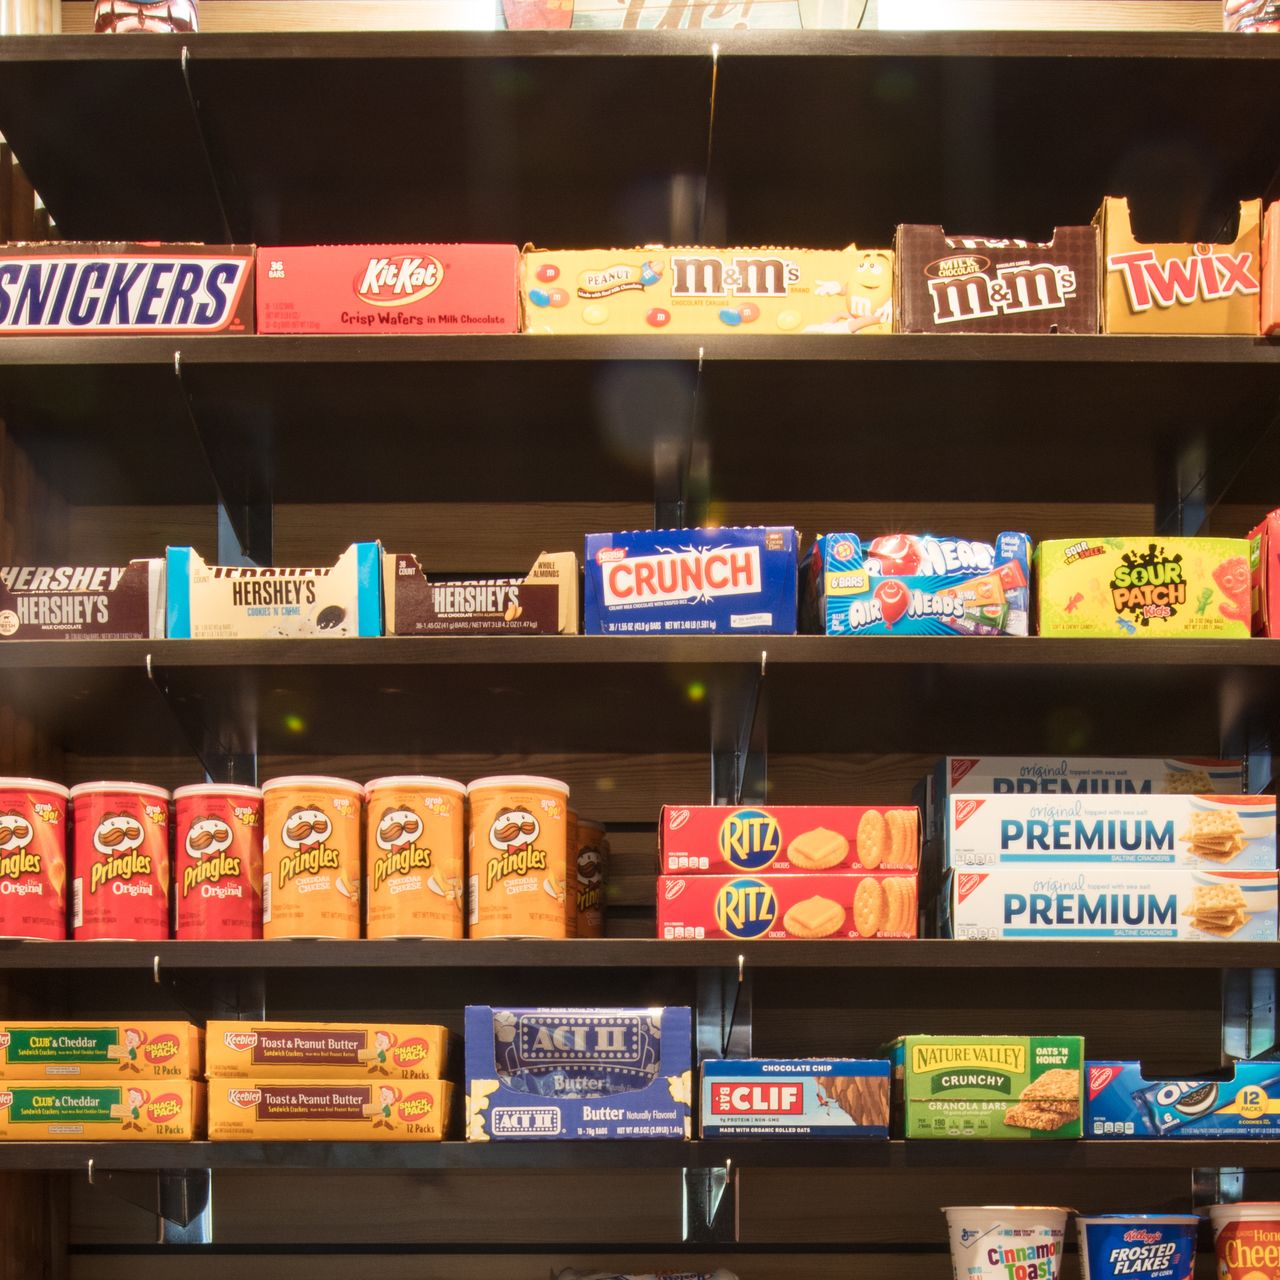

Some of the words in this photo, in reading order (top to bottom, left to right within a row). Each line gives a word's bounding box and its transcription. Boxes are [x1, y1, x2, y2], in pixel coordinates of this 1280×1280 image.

[341, 312, 374, 326] Crisp
[376, 311, 423, 326] Wafers
[438, 314, 458, 323] Milk
[460, 314, 505, 324] Chocolate
[608, 555, 754, 598] CRUNCH
[1115, 564, 1181, 588] SOUR
[1114, 584, 1186, 608] PATCH
[18, 597, 109, 624] HERSHEY'S
[723, 817, 778, 860] RITZ
[1000, 819, 1175, 851] PREMIUM
[917, 1048, 970, 1068] NATURE
[974, 1046, 1022, 1067] VALLEY
[1036, 1056, 1067, 1064] HONEY
[154, 1066, 160, 1074] 12
[163, 1066, 181, 1075] Packs
[941, 1076, 1004, 1088] CRUNCHY
[265, 1094, 288, 1104] Toast
[290, 1095, 296, 1103] &
[298, 1094, 330, 1105] Peanut
[332, 1094, 362, 1105] Butter
[732, 1088, 797, 1110] CLIF
[929, 1101, 978, 1112] GRANOLA
[982, 1101, 1006, 1110] BARS
[1242, 1092, 1260, 1105] 12
[583, 1106, 624, 1121] Butter
[627, 1111, 651, 1120] Naturally
[653, 1111, 676, 1120] Flavored
[1110, 1243, 1176, 1263] FROSTED
[1113, 1257, 1171, 1275] FLAKES
